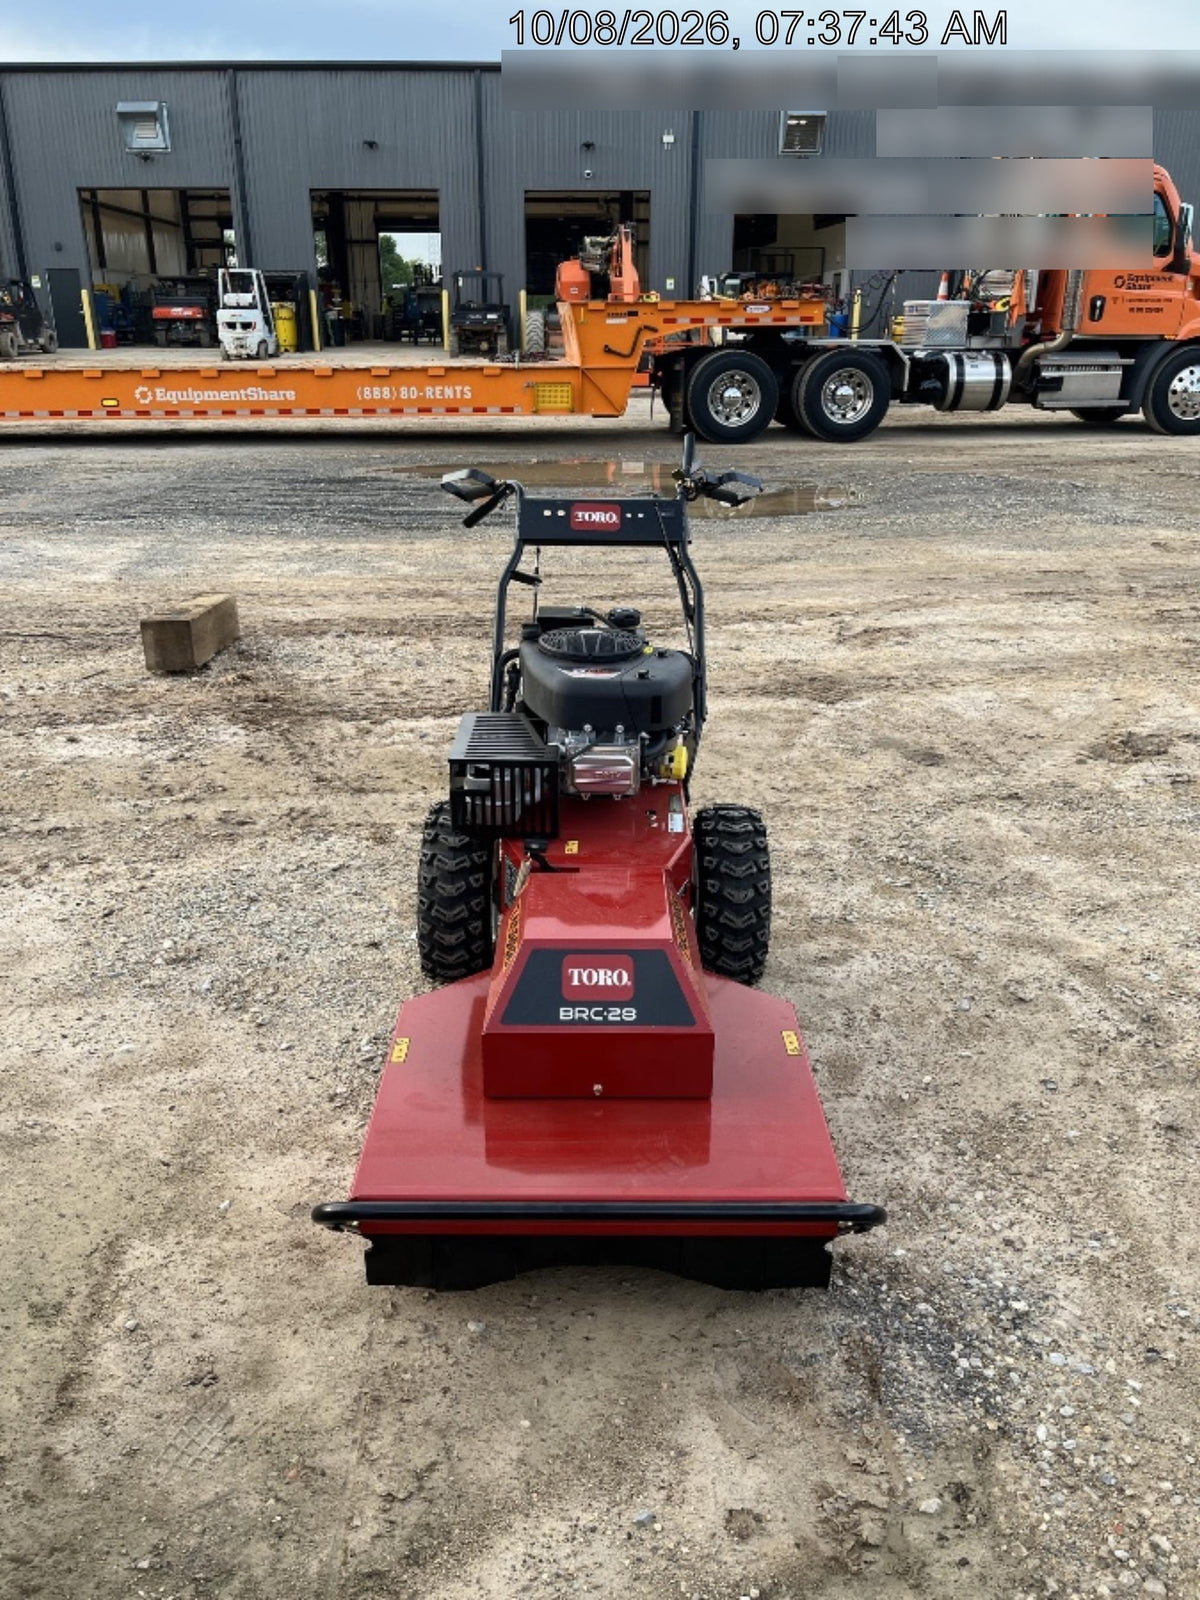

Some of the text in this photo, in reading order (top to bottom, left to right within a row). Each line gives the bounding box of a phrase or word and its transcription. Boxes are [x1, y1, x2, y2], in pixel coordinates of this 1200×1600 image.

[155, 386, 296, 404] EquipmentShare
[574, 511, 617, 523] TORO
[568, 968, 629, 986] TORO
